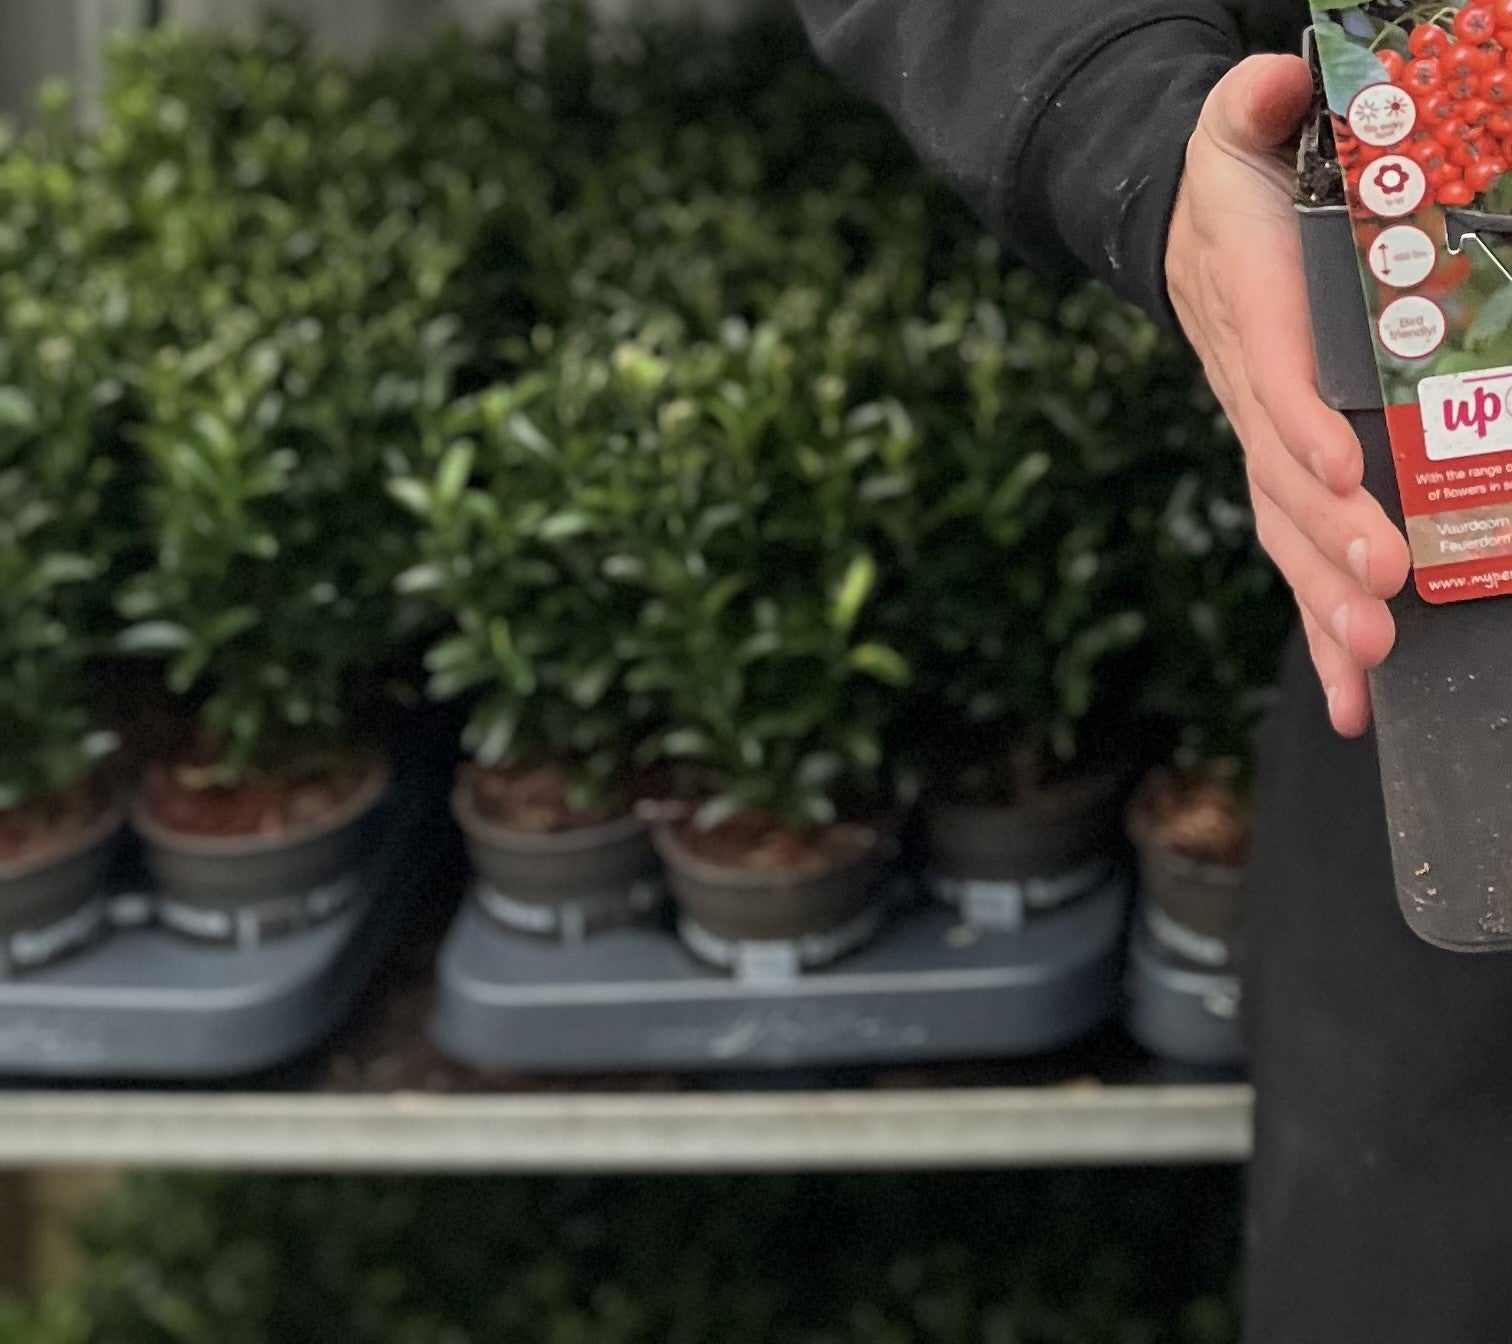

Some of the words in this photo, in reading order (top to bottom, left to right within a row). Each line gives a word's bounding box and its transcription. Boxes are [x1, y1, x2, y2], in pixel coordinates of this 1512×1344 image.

[1416, 472, 1444, 484] With
[1446, 468, 1466, 481] the
[1468, 466, 1502, 478] range
[1427, 488, 1441, 501] of
[1443, 484, 1486, 499] flowers
[1489, 481, 1501, 492] in
